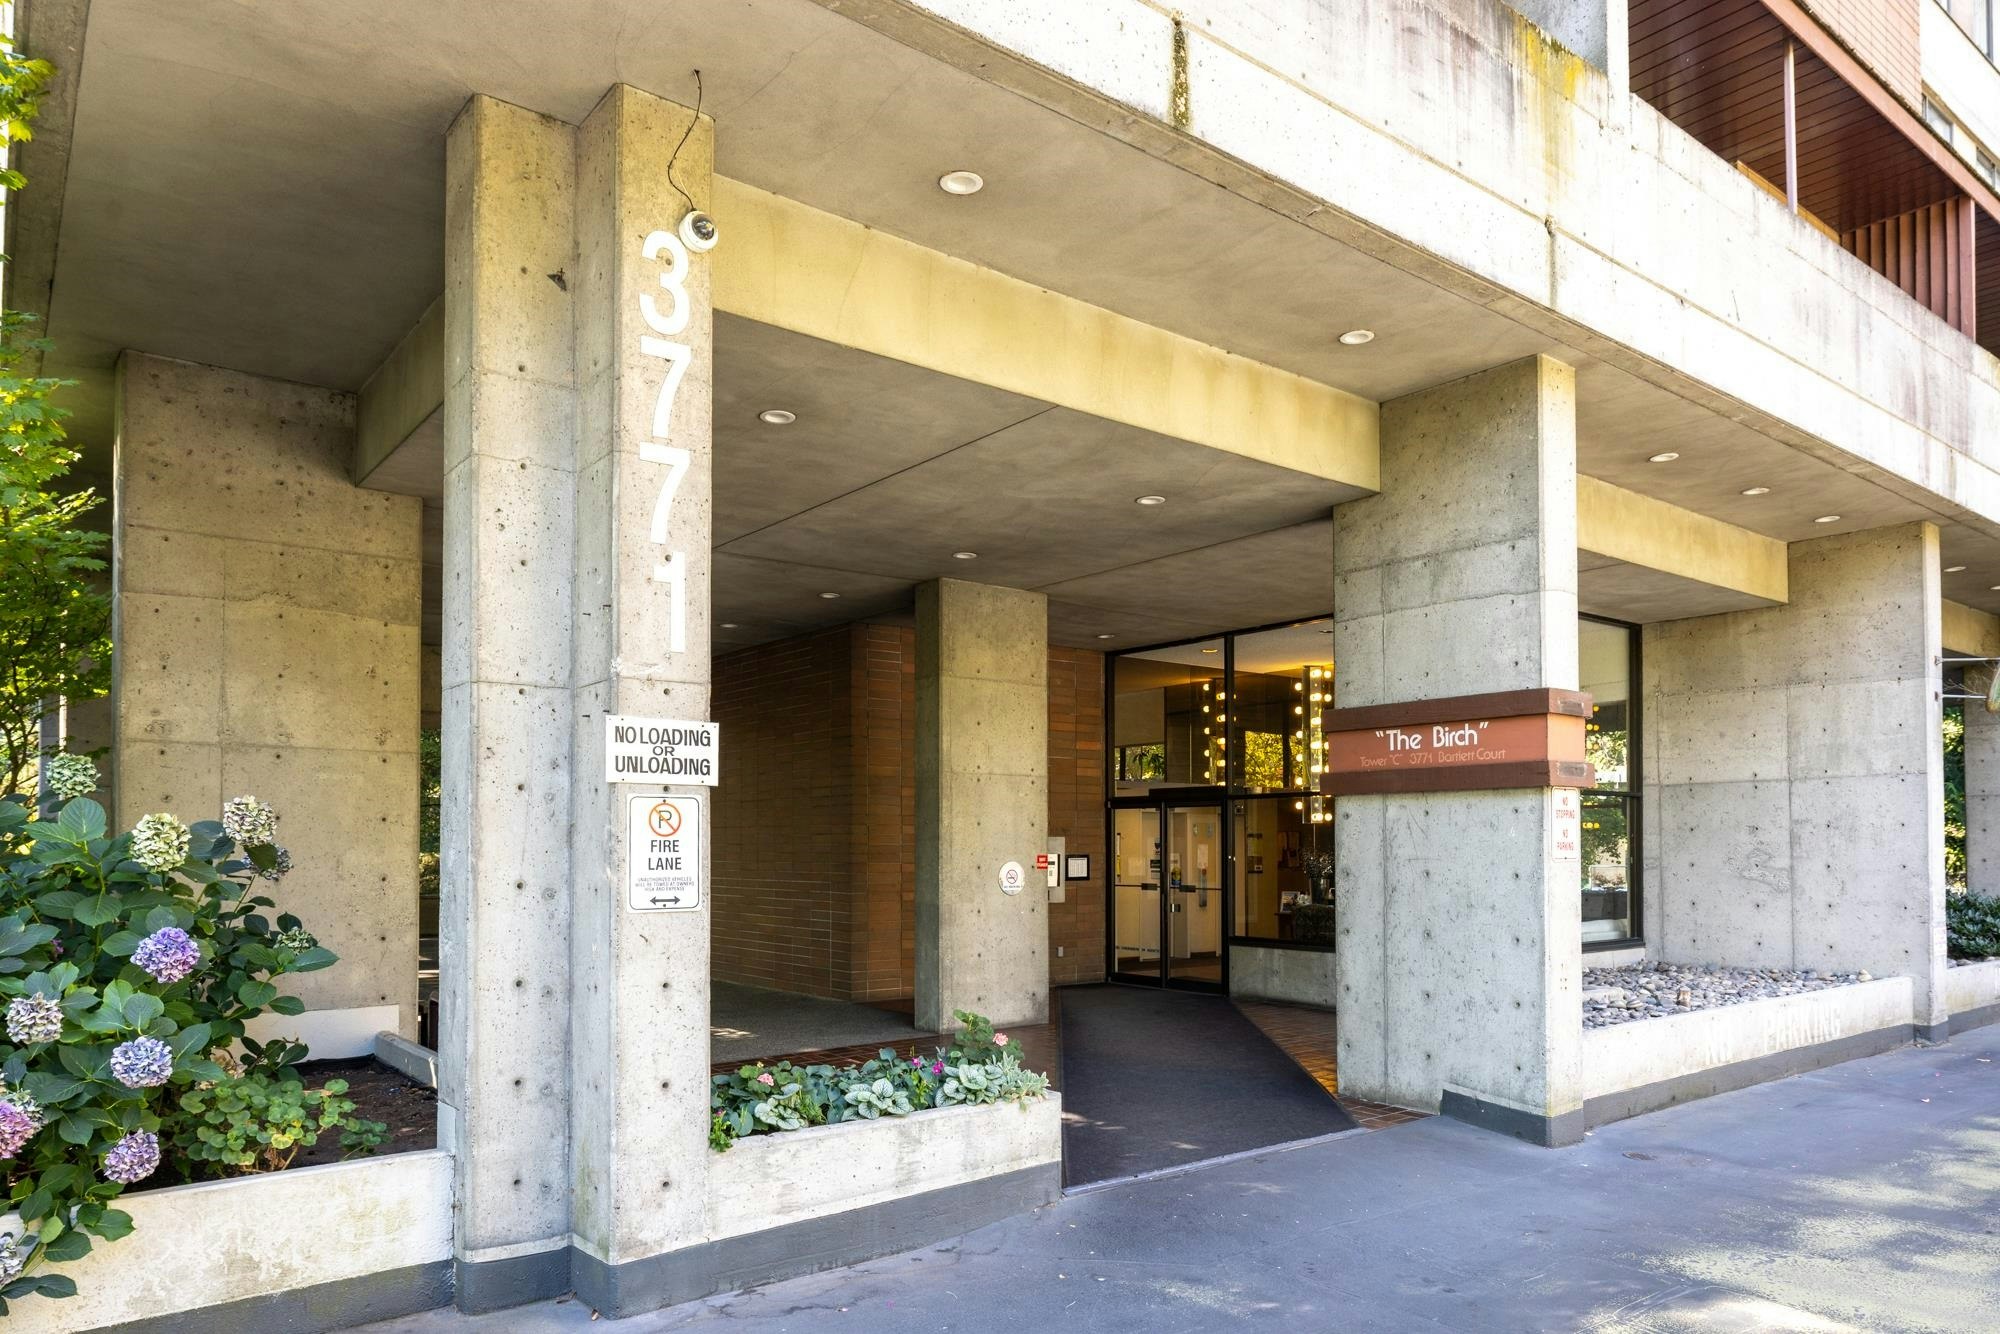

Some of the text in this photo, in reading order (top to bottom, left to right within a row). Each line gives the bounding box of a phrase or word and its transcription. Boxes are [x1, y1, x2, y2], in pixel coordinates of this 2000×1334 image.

[639, 230, 692, 653] 3771
[615, 725, 711, 747] NO LOADING
[652, 746, 675, 757] OR
[1359, 756, 1387, 767] Tower
[1408, 752, 1433, 765] 3771
[1438, 749, 1476, 763] Bartlett
[1476, 748, 1506, 760] Court
[615, 755, 711, 776] UNLOADING
[1561, 797, 1568, 806] NO
[1555, 809, 1576, 819] STOPPING
[1562, 829, 1569, 839] NO
[651, 839, 680, 853] FIRE
[1556, 842, 1575, 851] PARKING
[648, 857, 682, 871] LANE
[1763, 1002, 1841, 1055] PARKING
